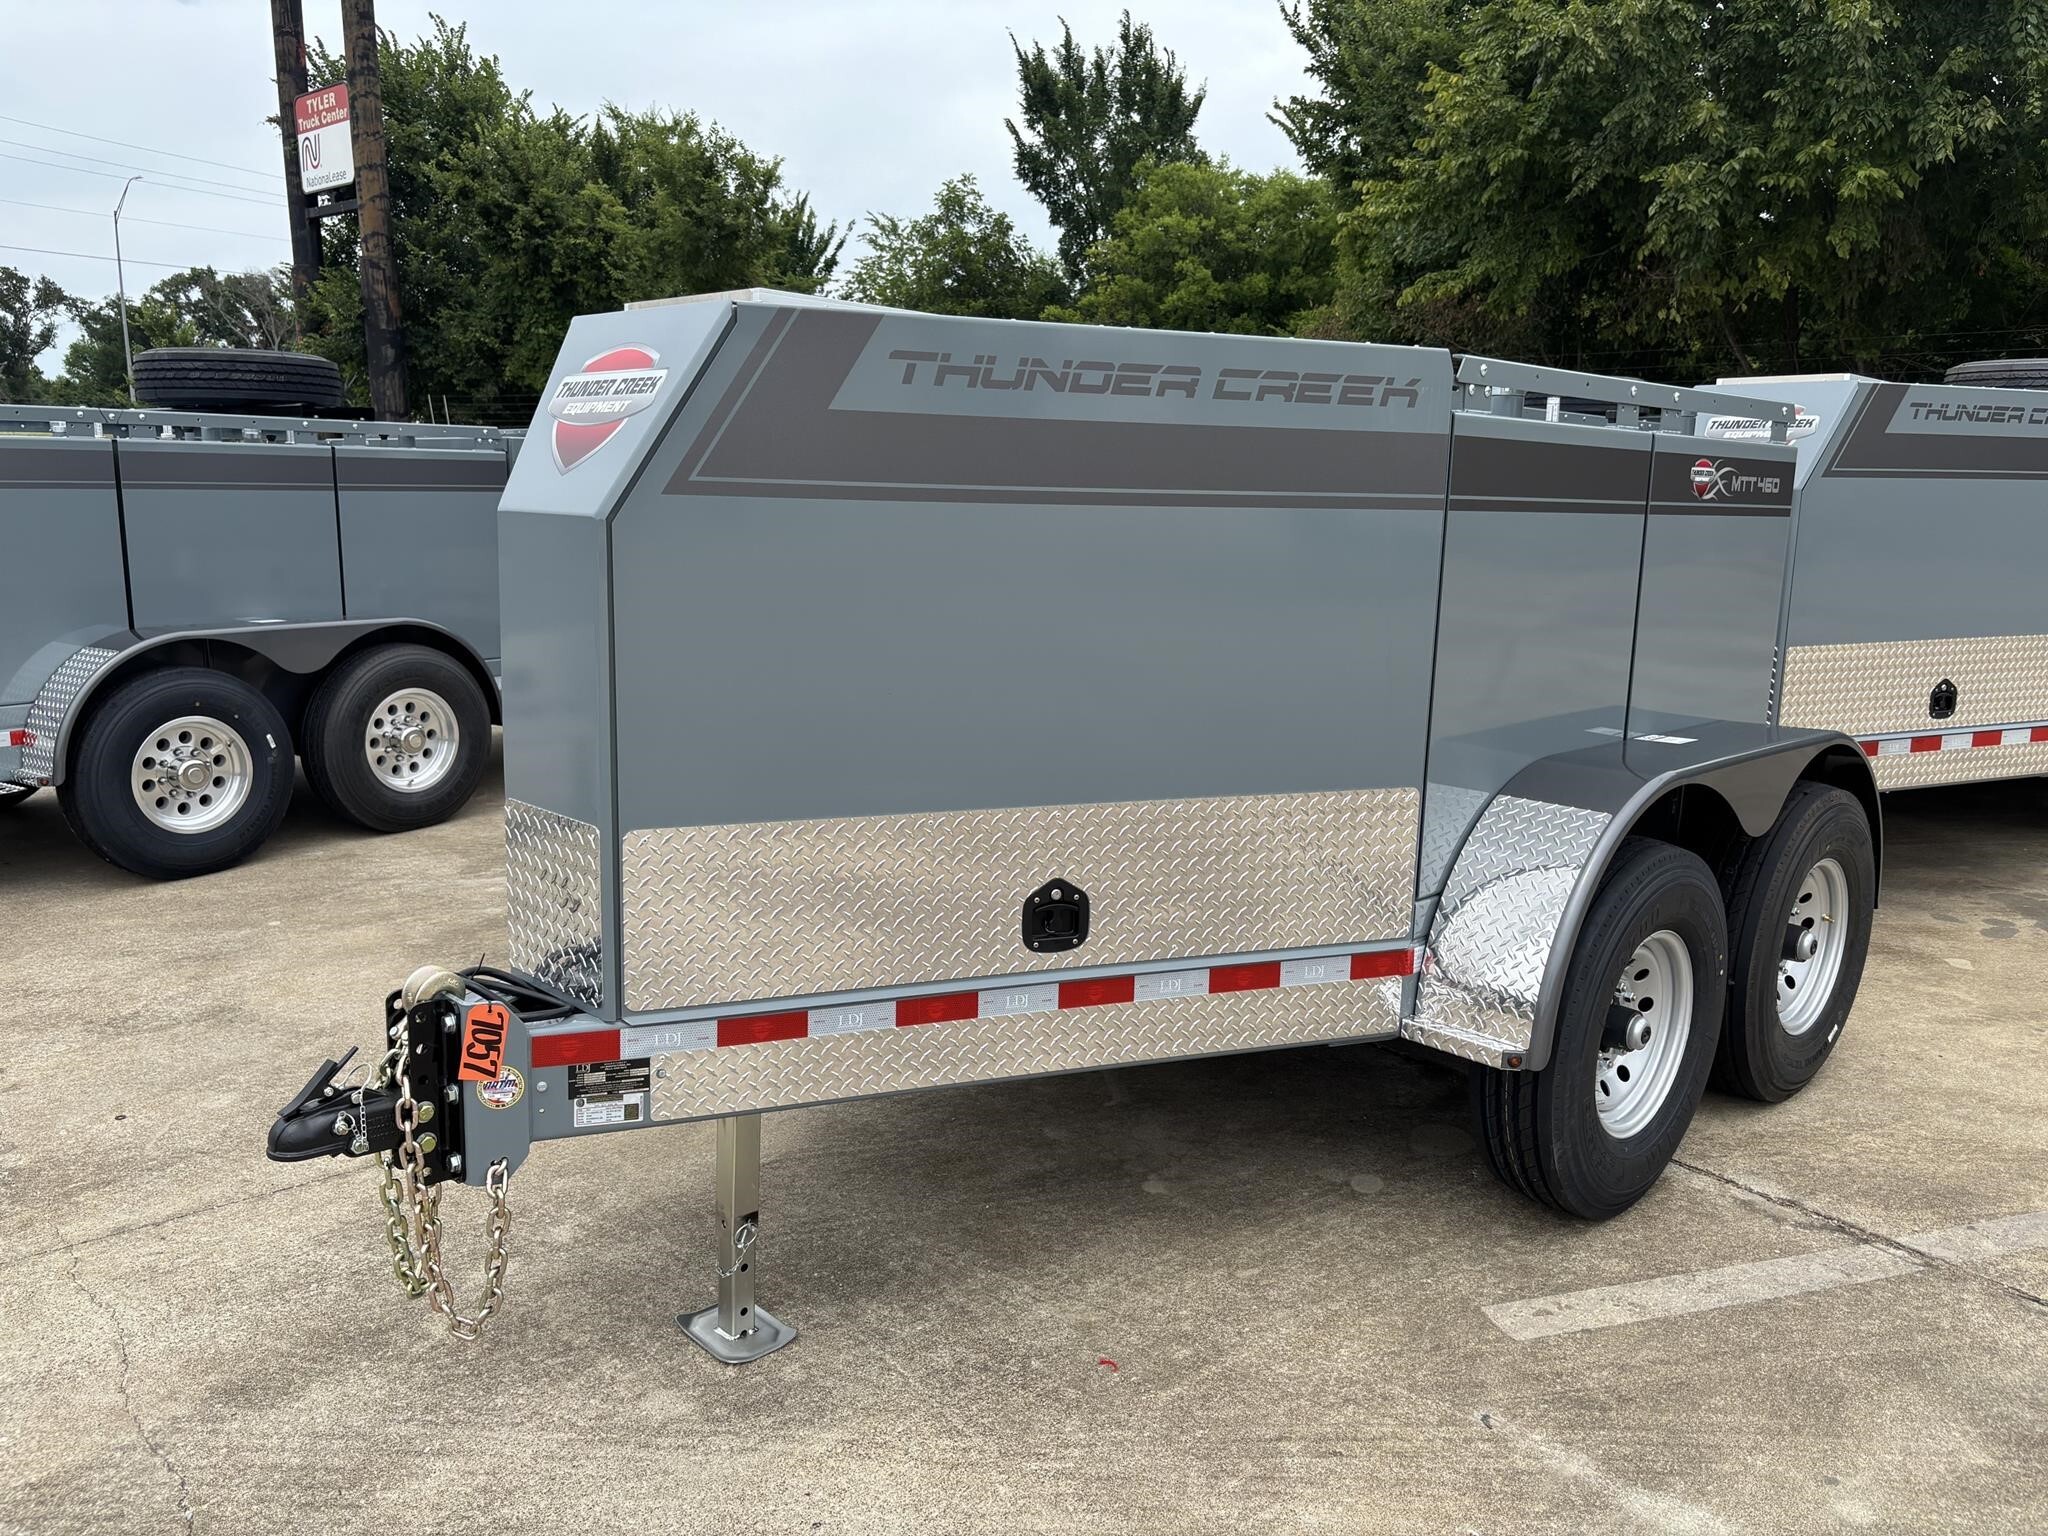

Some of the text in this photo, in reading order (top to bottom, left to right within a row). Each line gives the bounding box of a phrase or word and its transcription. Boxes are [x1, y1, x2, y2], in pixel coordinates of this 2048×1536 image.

[306, 92, 336, 114] TYLER
[298, 107, 348, 131] Truck Center
[556, 375, 663, 399] THUNDER CREEK
[888, 349, 1422, 408] THUNDER CREEK
[562, 399, 632, 416] EQUIPMENT
[1910, 402, 2026, 424] THUNDER
[463, 1012, 504, 1079] 7057
